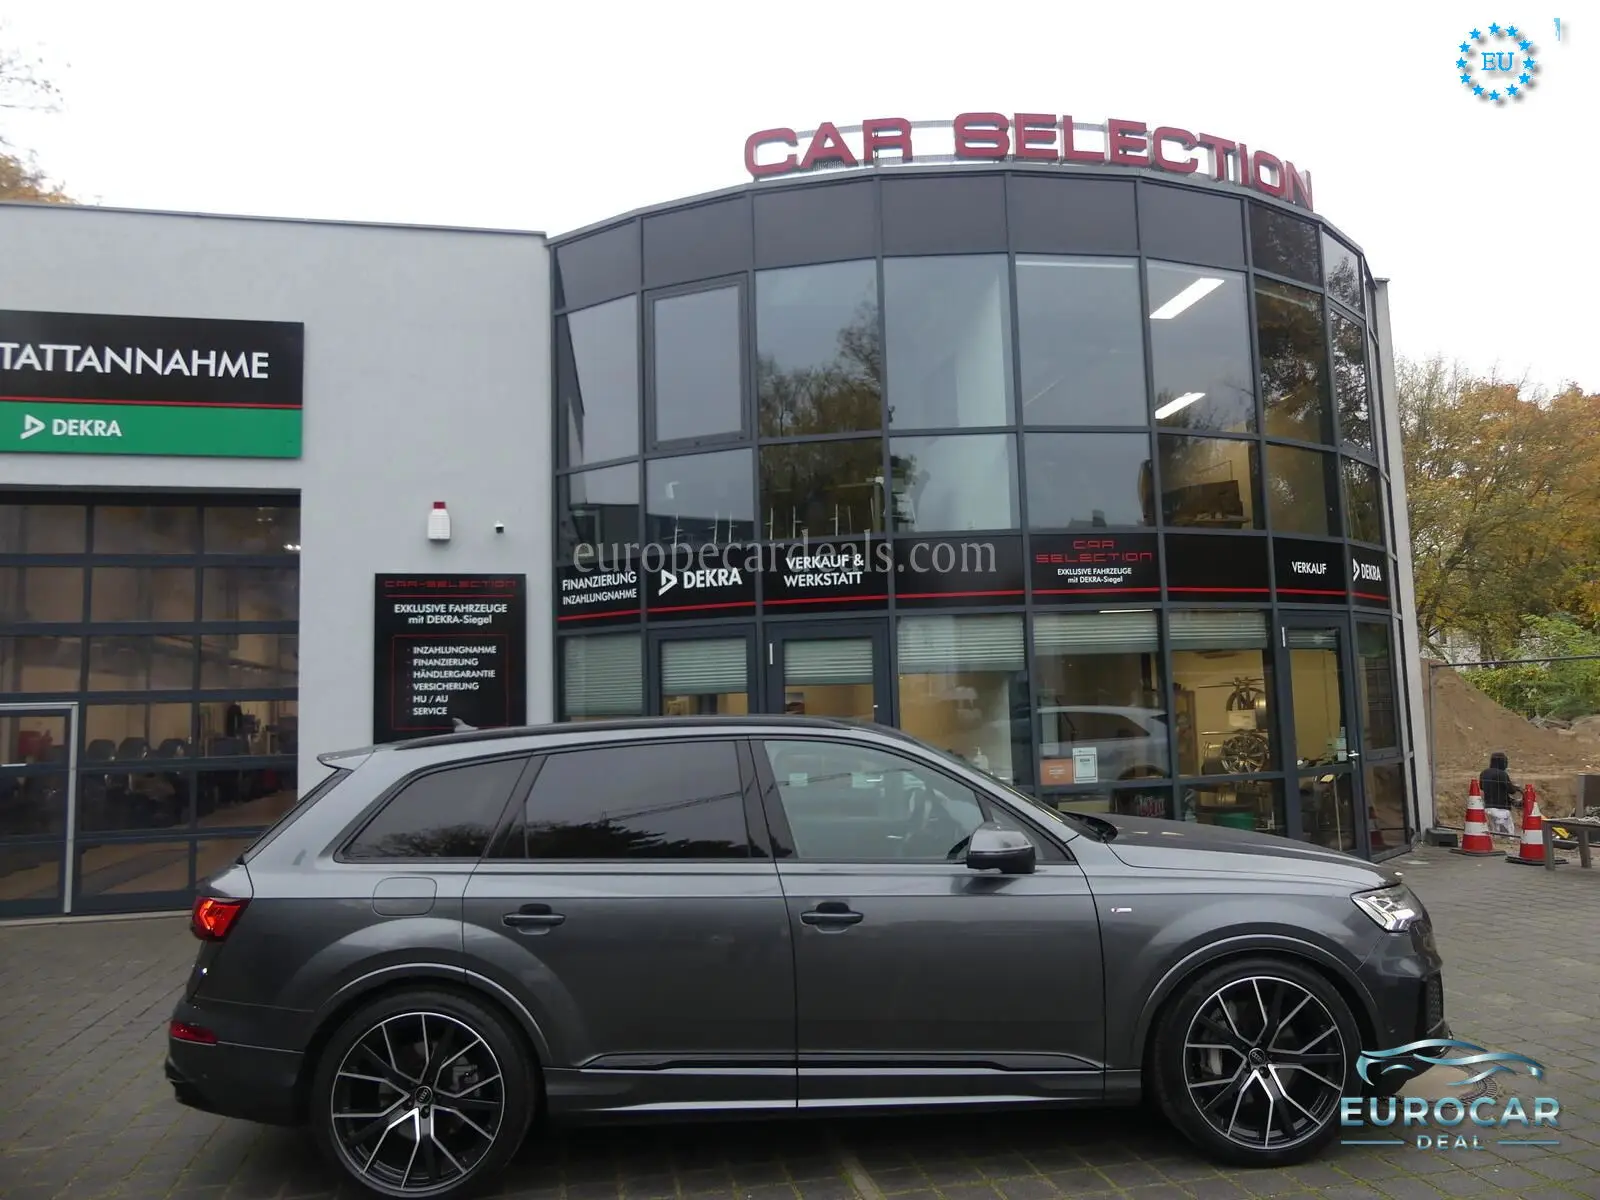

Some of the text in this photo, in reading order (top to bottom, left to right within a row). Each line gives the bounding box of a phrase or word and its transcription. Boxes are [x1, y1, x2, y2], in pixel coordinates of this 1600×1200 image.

[744, 112, 1313, 211] CAR SELECTION
[52, 418, 122, 437] DEKRA
[1072, 540, 1115, 550] CAR
[785, 553, 864, 570] VERKAUF &
[1036, 552, 1153, 563] SELECTION
[1057, 567, 1132, 576] EXKLUSIVE FAHRZEUGE
[1291, 561, 1327, 575] VERKAUF
[1361, 563, 1382, 581] DEKRA
[562, 571, 637, 591] FINANZIERUNG
[683, 567, 743, 589] DEKRA
[783, 571, 864, 588] WERKSTATT
[1067, 576, 1123, 584] mit DEKRA-Siegel
[562, 588, 637, 605] INZAHLUNGNAHME
[394, 604, 507, 613] EXKLUSIVE FAHRZEUGE
[408, 615, 492, 625] mit DEKRA-Siegel
[413, 646, 497, 654] INZAHLUNGNAHME
[413, 658, 479, 666] FINANZIERUNG
[413, 670, 496, 678] HÄNDLERGARANTIE
[413, 682, 479, 691] VERSICHERUNG
[413, 695, 427, 703] HU
[435, 695, 449, 703] AU
[413, 707, 448, 715] SERVICE
